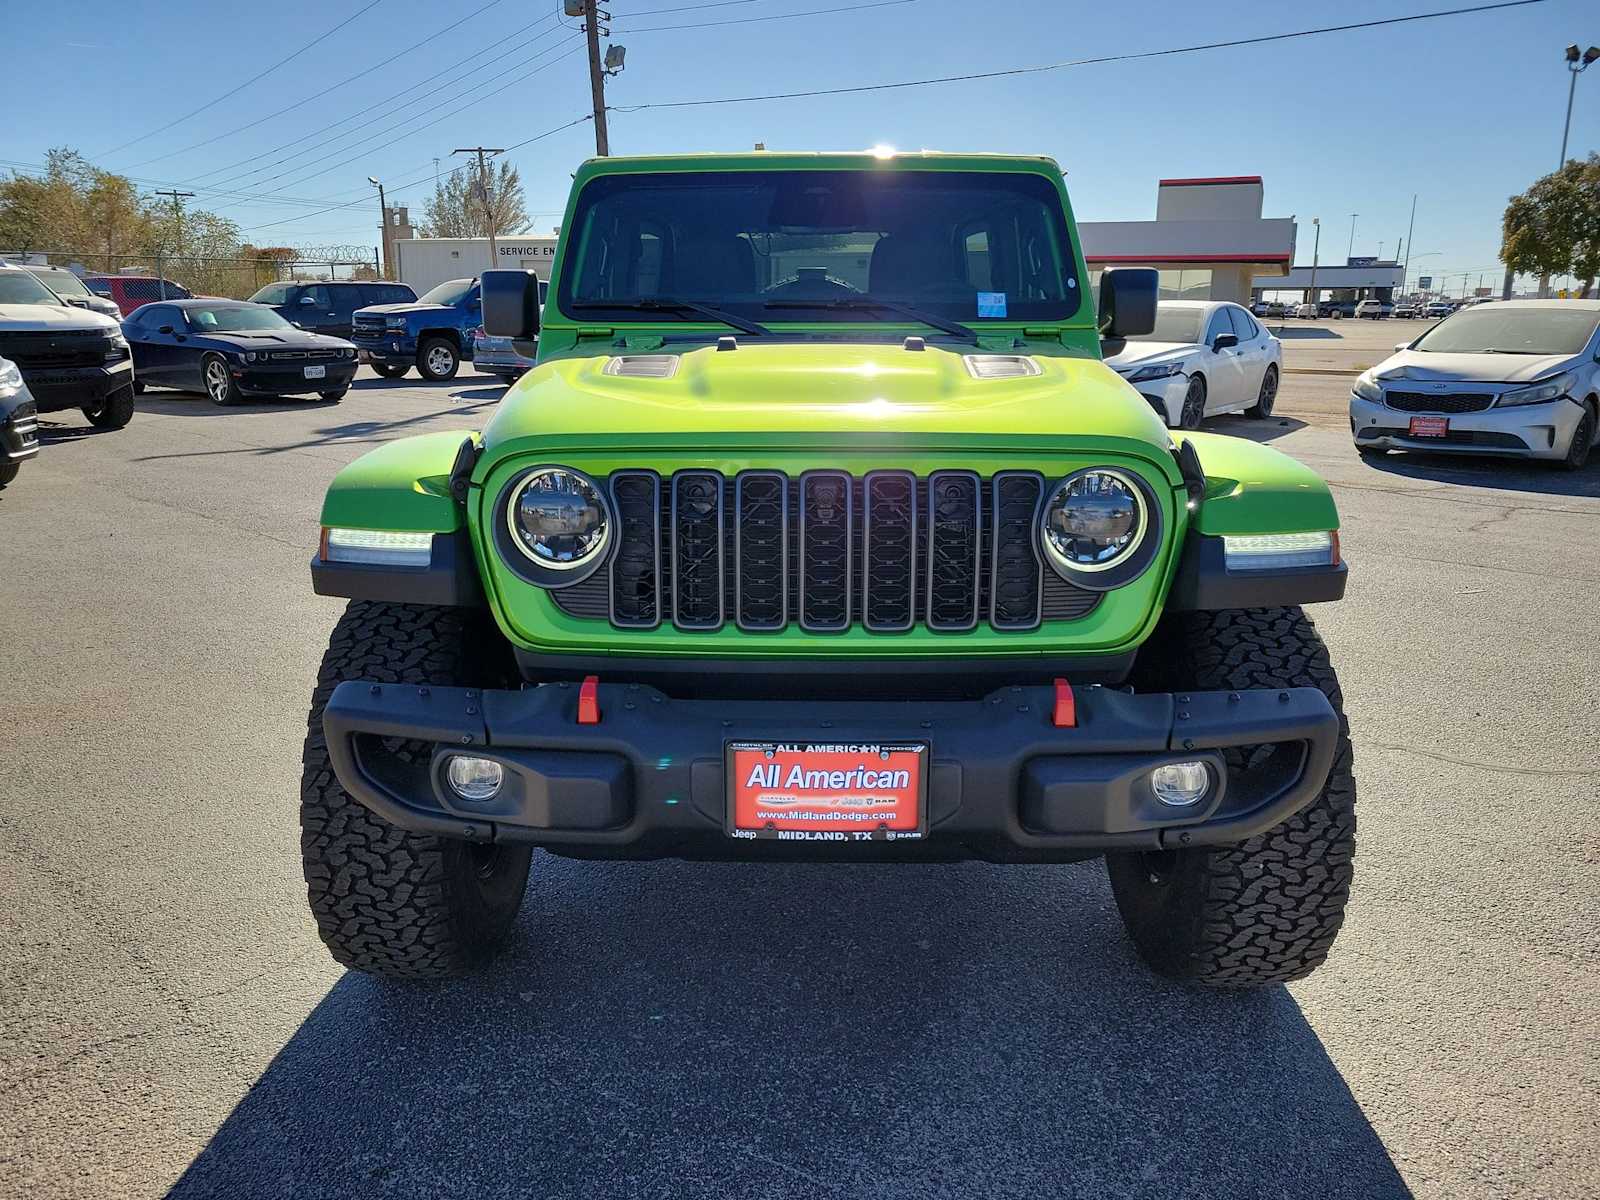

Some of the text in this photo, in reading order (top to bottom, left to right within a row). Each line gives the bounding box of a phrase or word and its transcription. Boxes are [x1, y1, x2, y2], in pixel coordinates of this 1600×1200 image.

[500, 247, 539, 256] SERVICE
[776, 744, 801, 753] ALL
[746, 763, 910, 790] All American
[756, 811, 897, 822] www.MidlandDodge.com
[731, 829, 757, 840] Jeep
[778, 831, 873, 842] MIDLAND, TX
